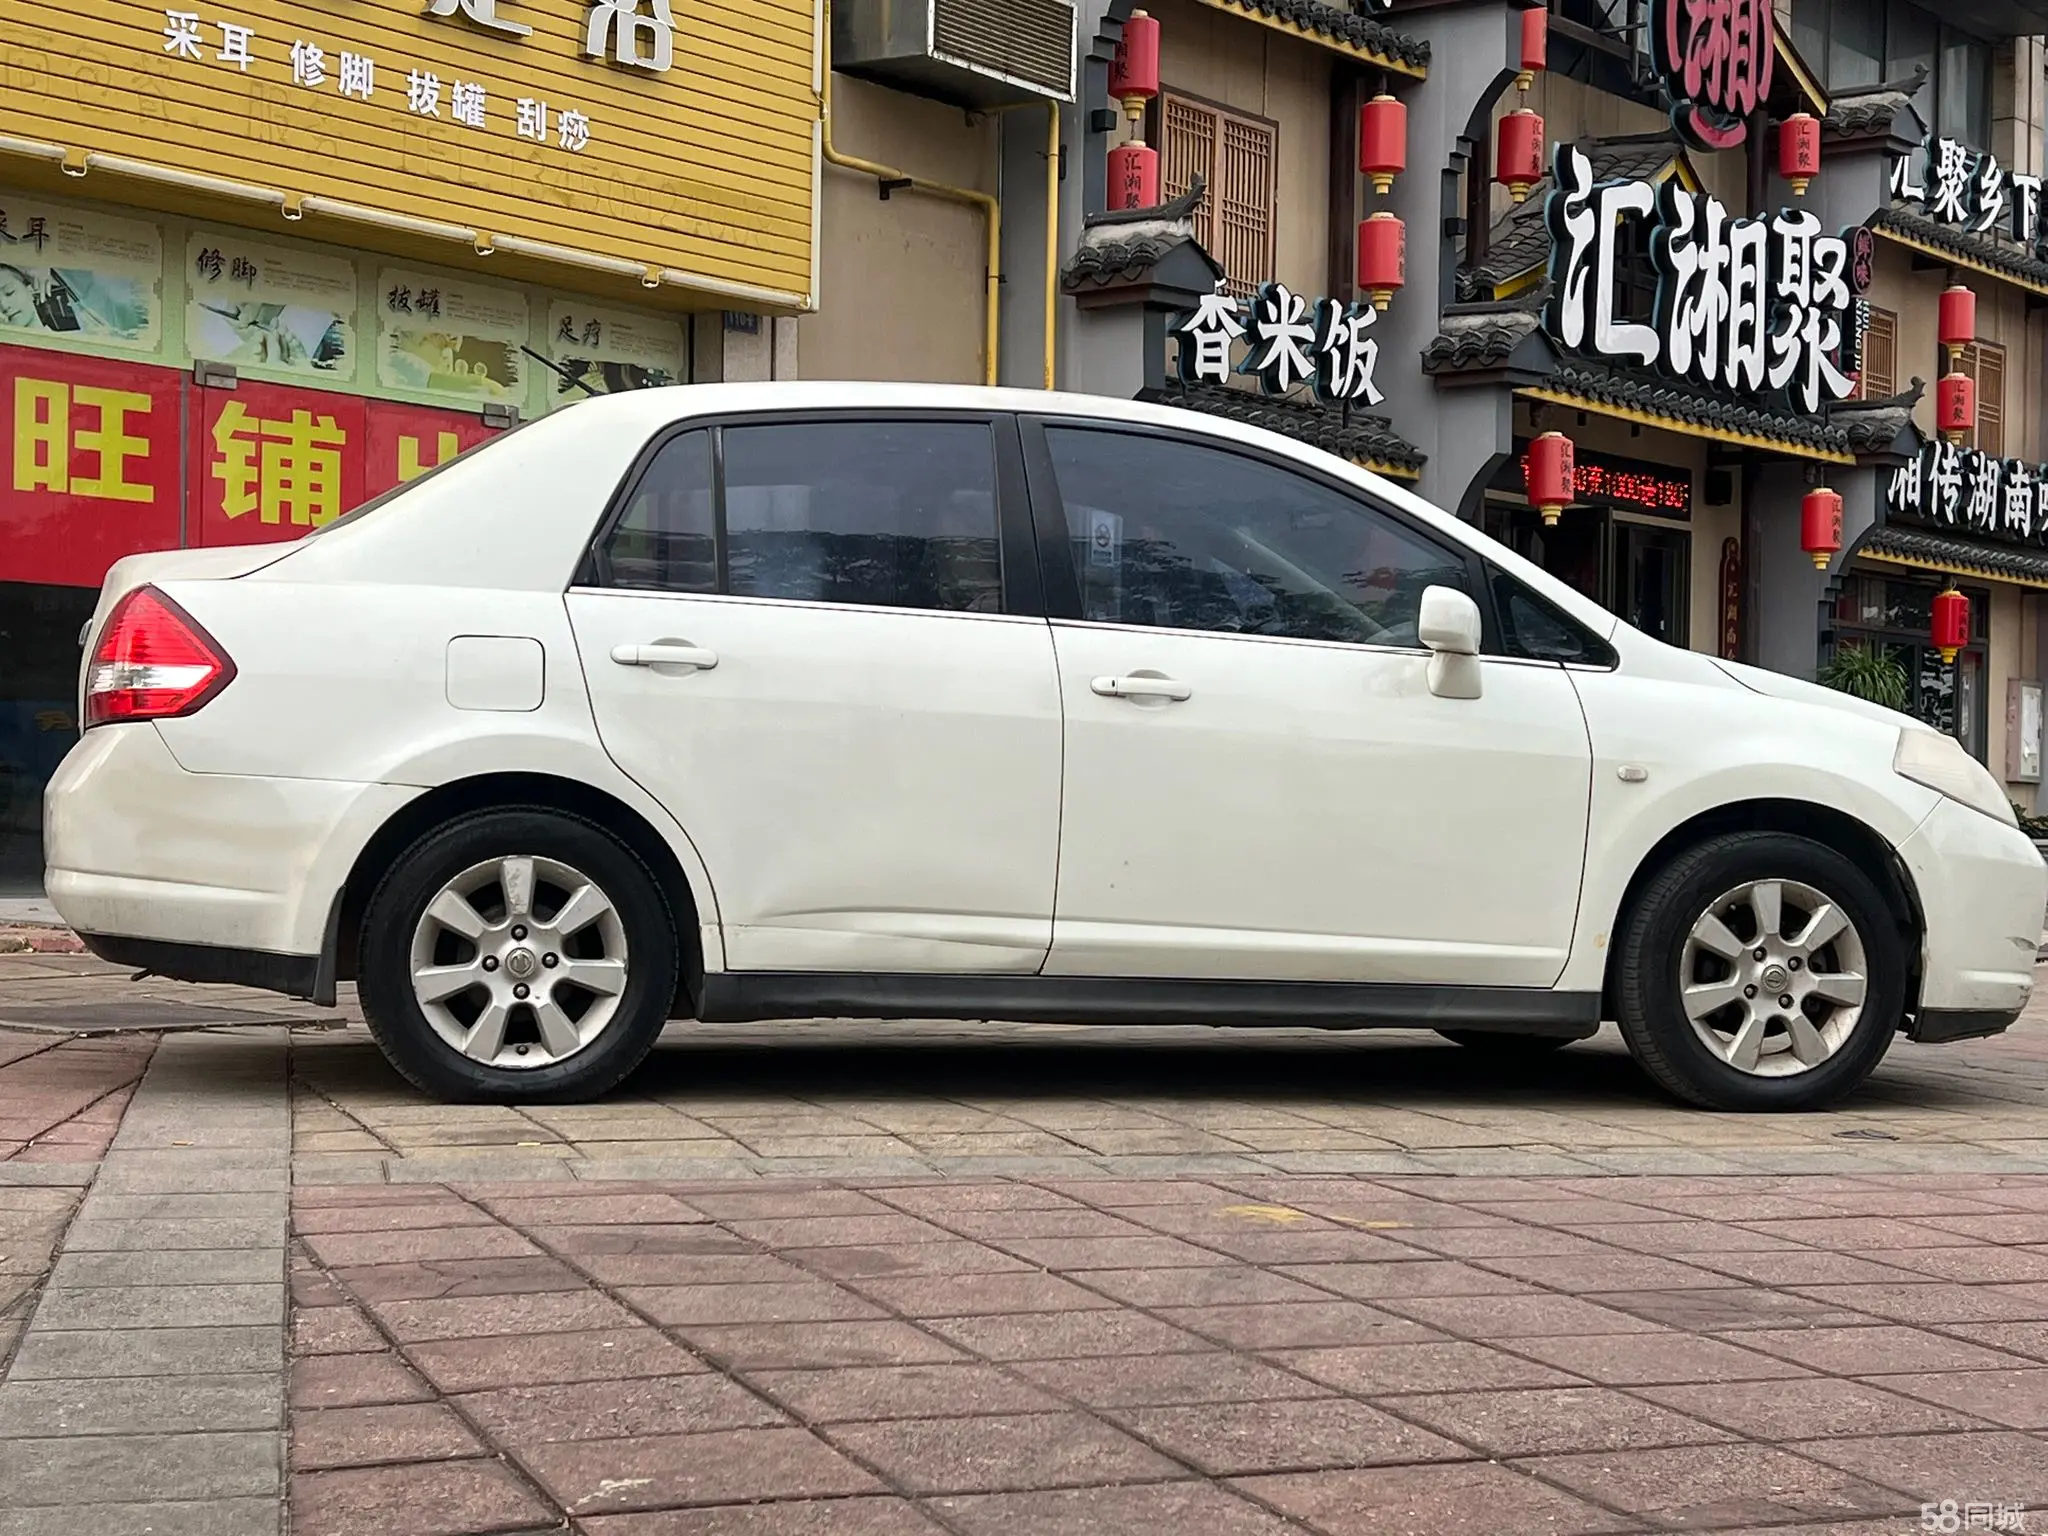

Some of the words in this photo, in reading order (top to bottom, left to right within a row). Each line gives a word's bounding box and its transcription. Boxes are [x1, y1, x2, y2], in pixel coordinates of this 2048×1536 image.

[163, 9, 255, 72] 采耳
[289, 39, 374, 101] 修脚
[406, 68, 487, 128] 拔罐
[515, 98, 590, 151] 刮痧
[1114, 33, 1129, 81] 湘聚
[1796, 121, 1812, 168] 汇湘聚
[197, 248, 257, 290] 修脚
[1561, 145, 1856, 413] 汇湘聚
[388, 285, 441, 319] 拔罐
[558, 315, 602, 347] 足疗
[1181, 278, 1385, 406] 香米饭
